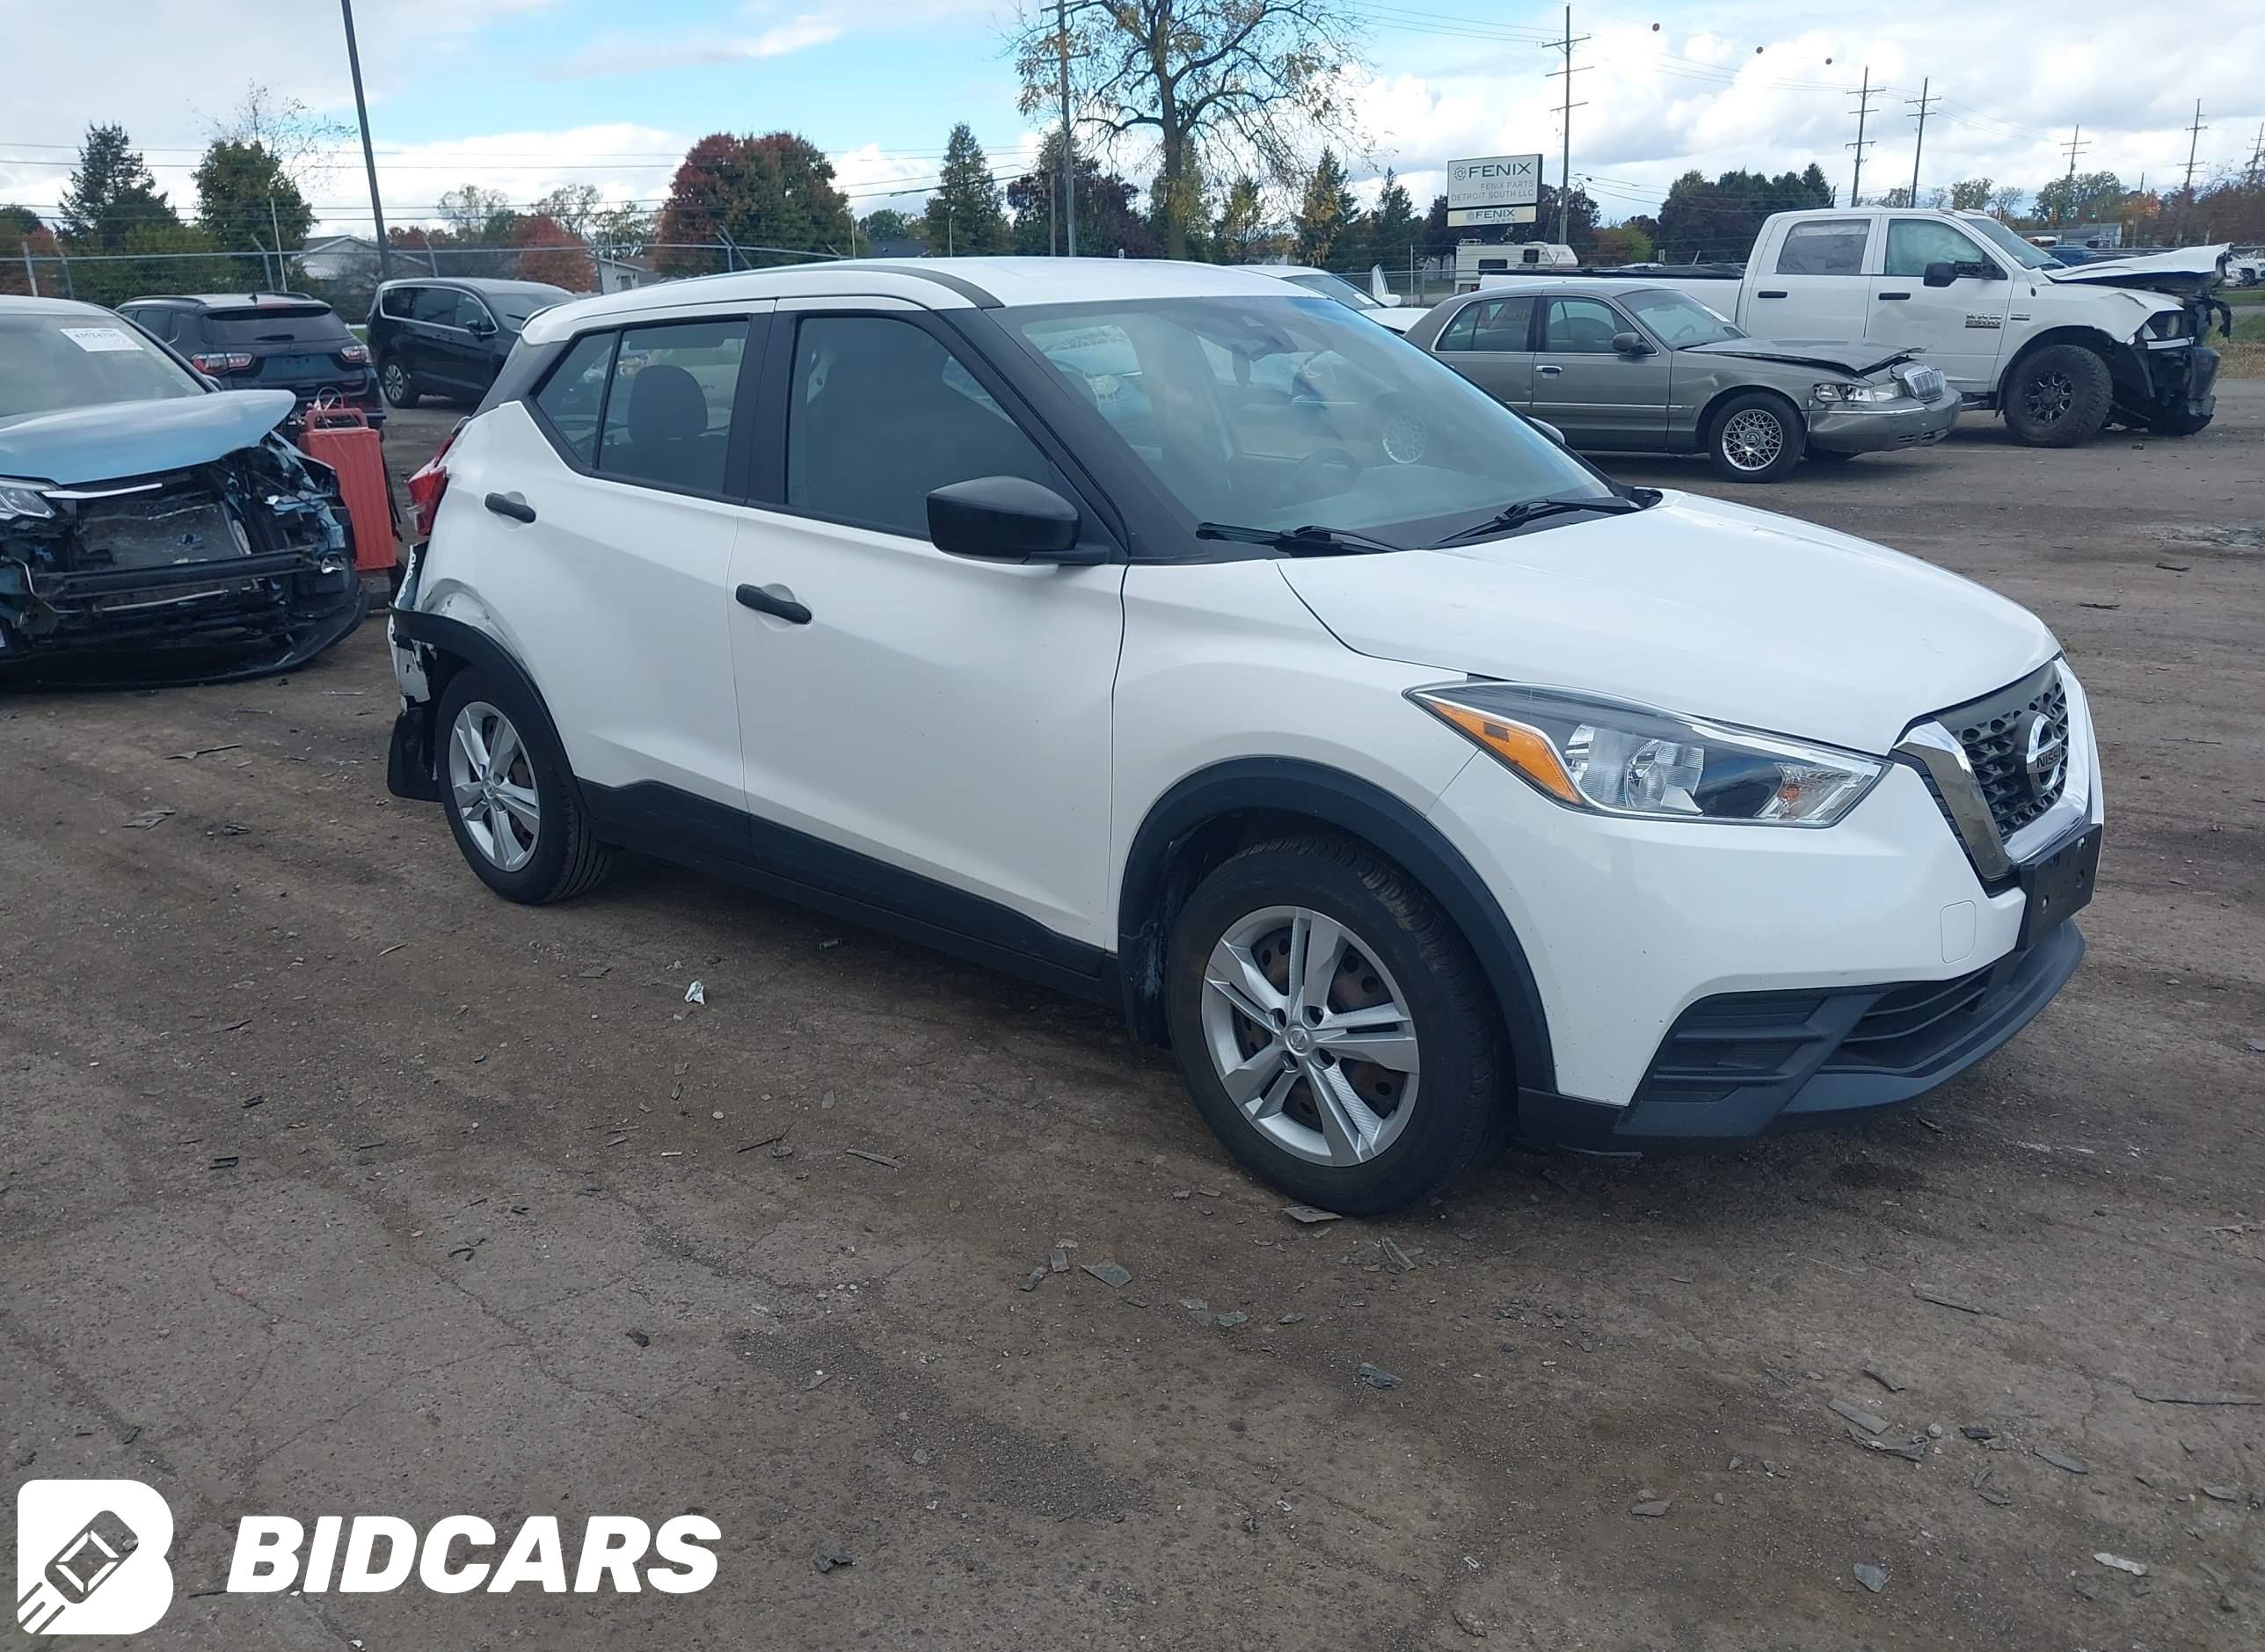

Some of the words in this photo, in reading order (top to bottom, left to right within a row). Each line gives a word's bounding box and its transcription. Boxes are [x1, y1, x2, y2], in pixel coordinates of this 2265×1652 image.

[1469, 163, 1532, 178] FENIX
[1507, 180, 1533, 189] PARTS
[1451, 193, 1485, 201] DETROIT
[1488, 190, 1515, 199] SOUTH
[1475, 209, 1515, 219] FENIX
